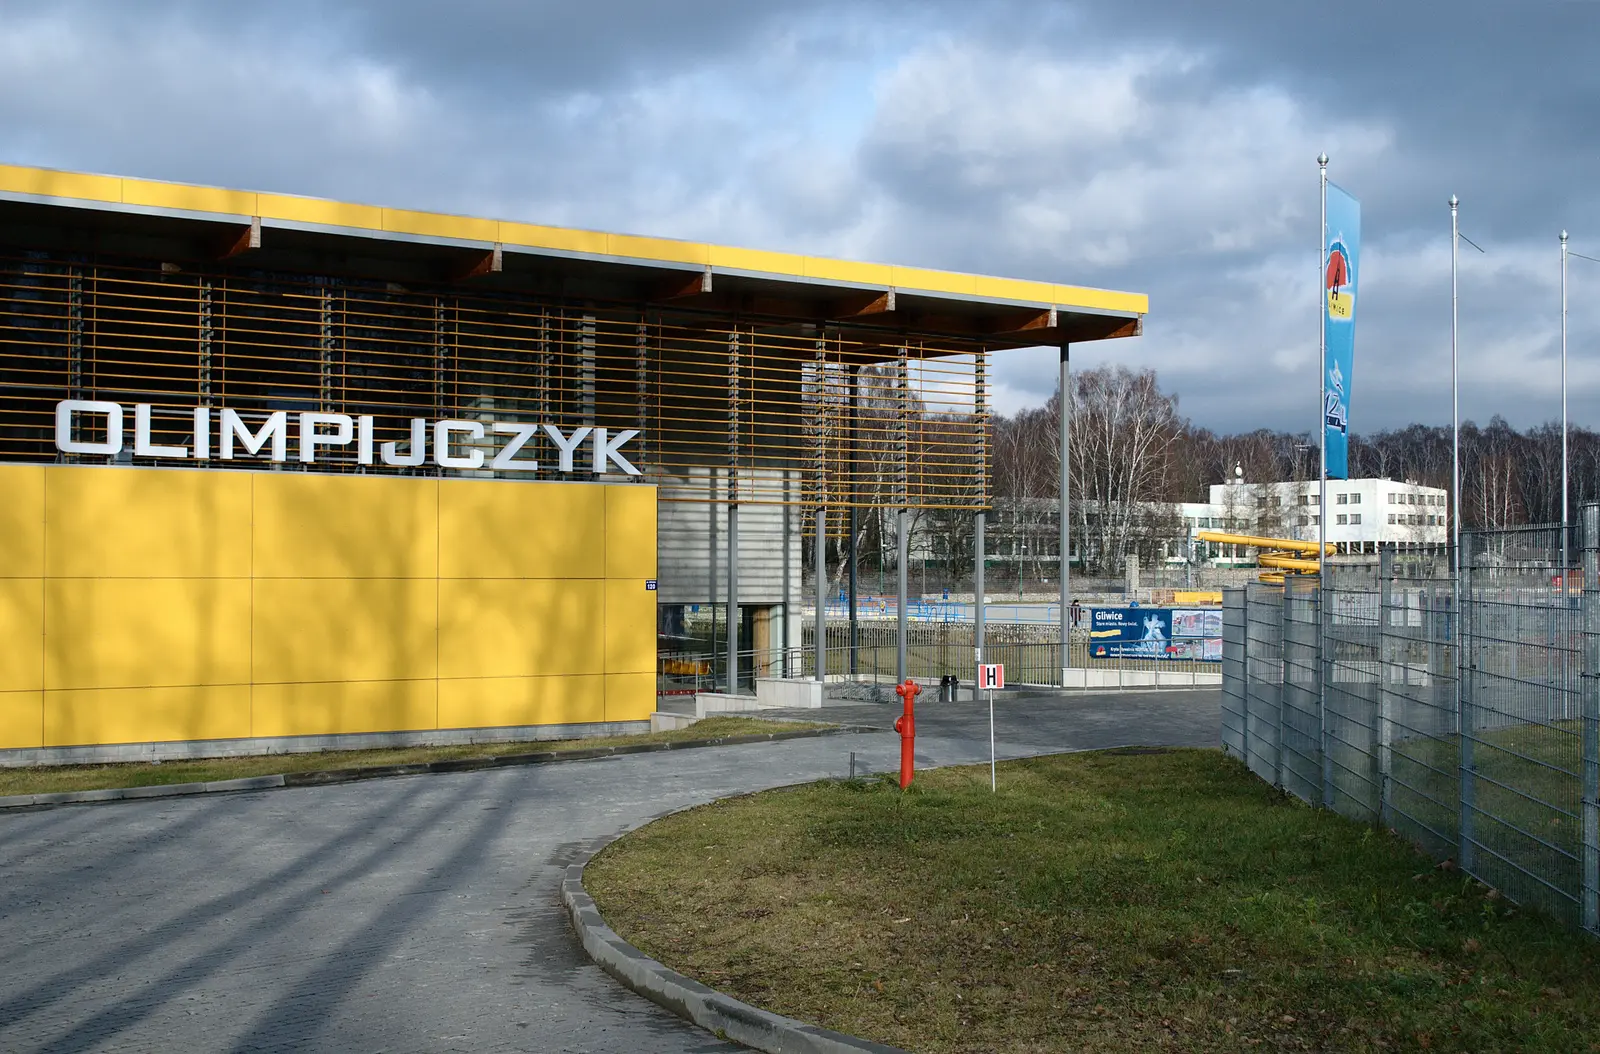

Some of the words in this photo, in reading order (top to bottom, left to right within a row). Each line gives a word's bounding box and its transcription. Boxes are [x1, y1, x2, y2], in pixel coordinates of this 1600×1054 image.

[55, 400, 642, 476] OLIMPIJCZYK
[1095, 611, 1123, 620] Gliwice
[986, 667, 996, 686] H
